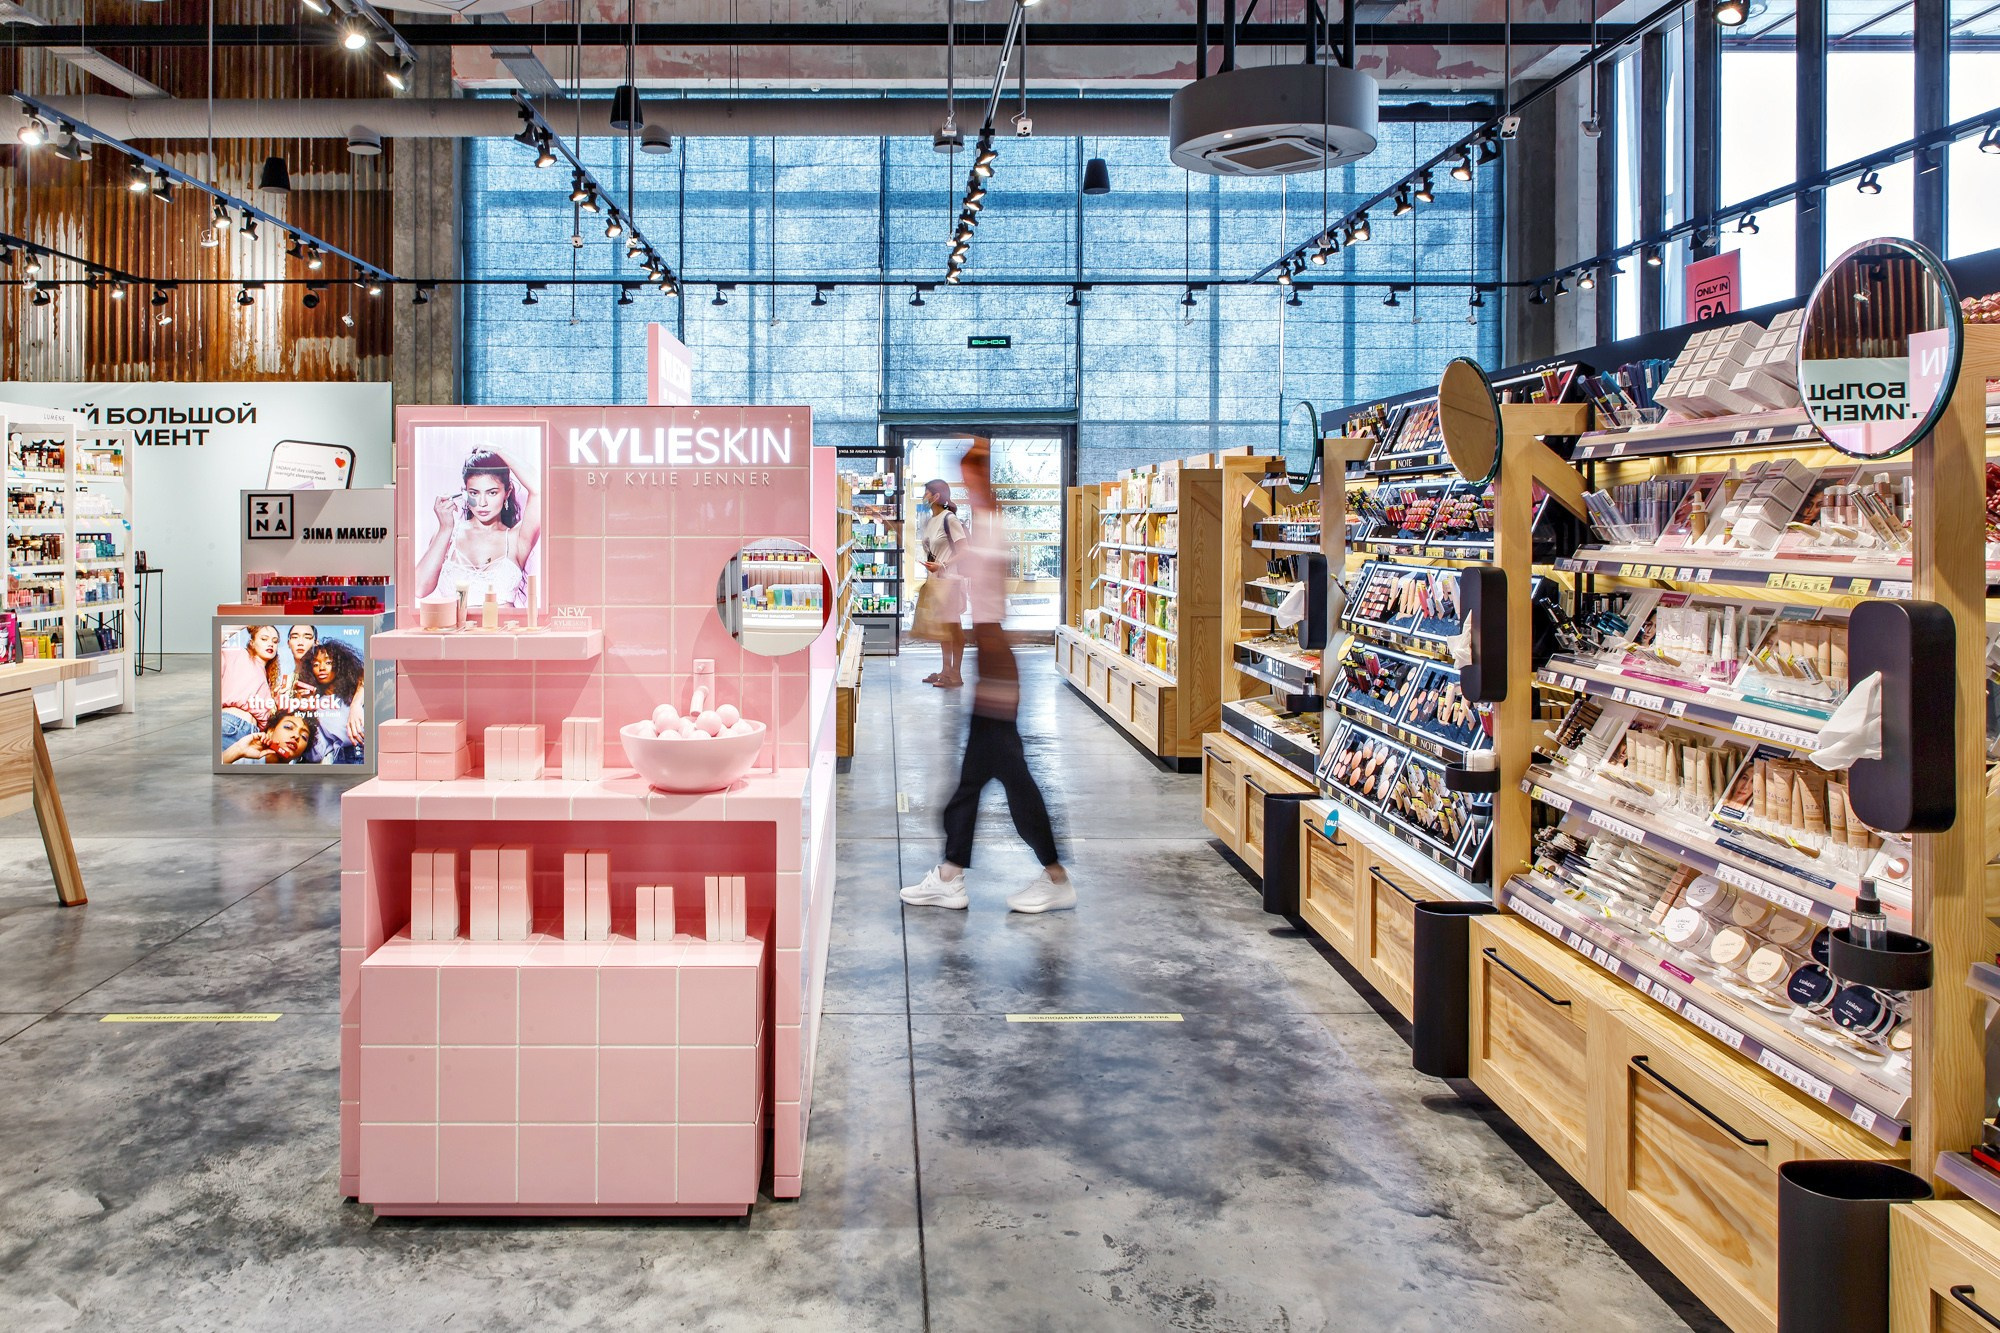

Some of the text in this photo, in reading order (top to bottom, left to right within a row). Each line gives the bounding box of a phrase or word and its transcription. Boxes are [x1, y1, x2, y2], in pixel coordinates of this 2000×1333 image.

[1697, 282, 1728, 297] ONLY IN
[106, 402, 257, 424] БОЛЬШОЙ
[569, 427, 791, 464] KYLIESKIN
[1398, 458, 1412, 467] NOTE
[587, 472, 771, 485] BY KYLIE JENNER
[303, 527, 387, 540] 3INA MAKEUP
[557, 607, 586, 616] NEW
[248, 694, 341, 711] the lipstick
[1326, 819, 1338, 827] SALE
